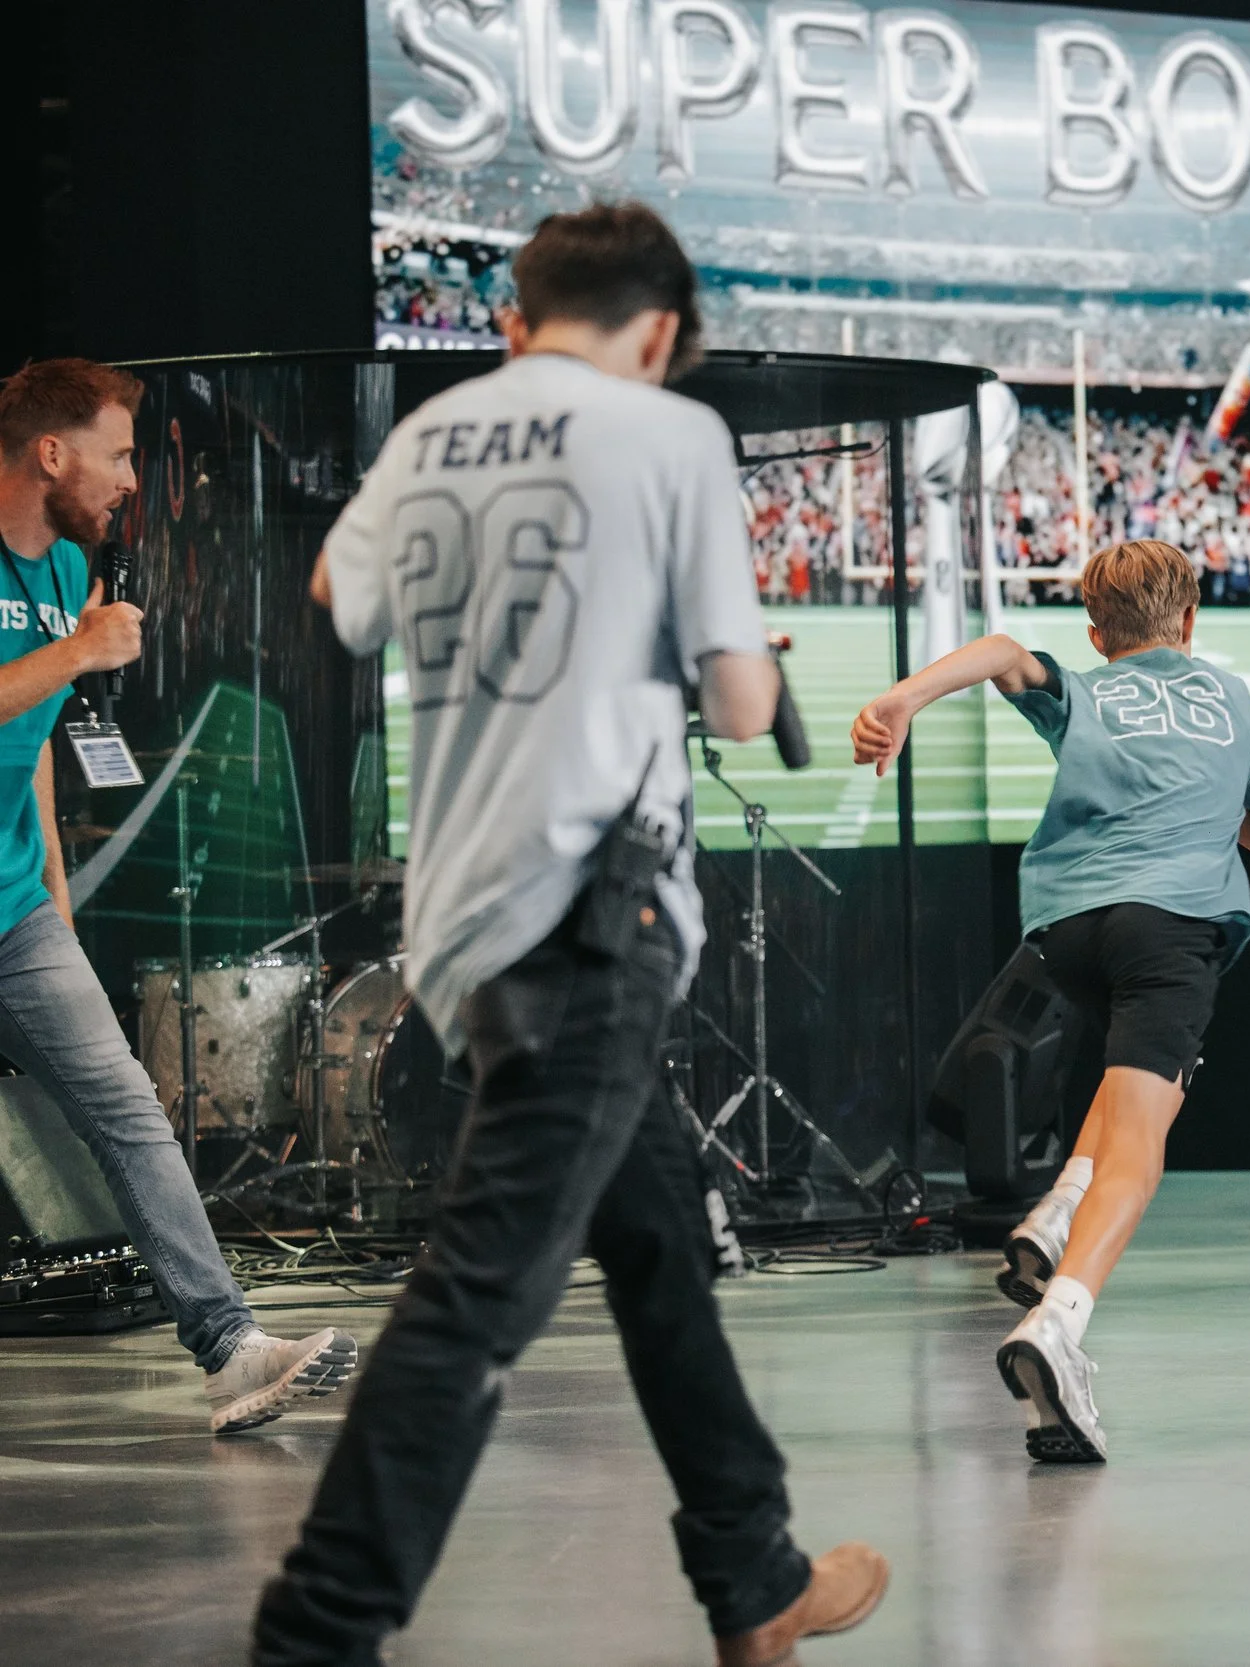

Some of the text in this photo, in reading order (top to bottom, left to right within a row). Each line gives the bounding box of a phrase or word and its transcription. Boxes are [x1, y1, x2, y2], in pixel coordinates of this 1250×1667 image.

[388, 0, 990, 200] SUPER
[415, 410, 574, 472] TEAM
[393, 479, 591, 711] 26
[1093, 671, 1234, 746] 26
